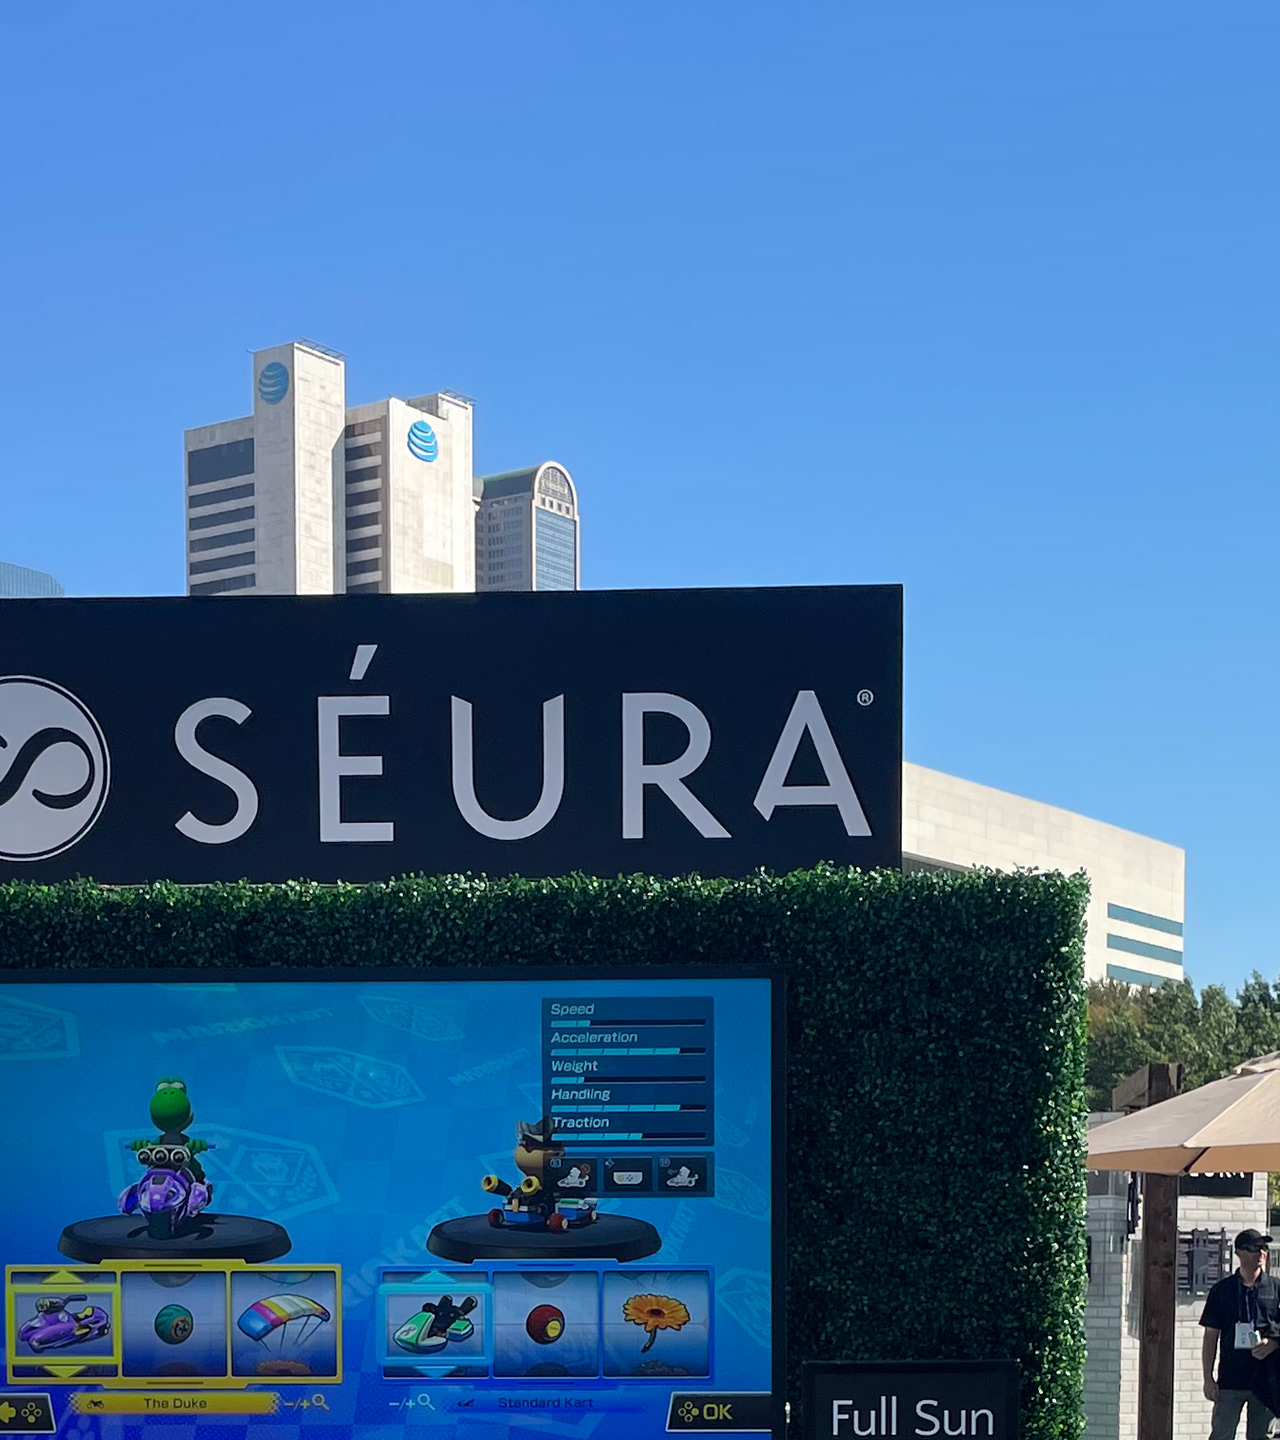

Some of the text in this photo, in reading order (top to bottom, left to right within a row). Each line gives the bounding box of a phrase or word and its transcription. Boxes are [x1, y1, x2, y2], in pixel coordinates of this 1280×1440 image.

[550, 1003, 595, 1017] Speed
[550, 1032, 638, 1043] Acceleration
[551, 1060, 599, 1073] Weight
[551, 1089, 611, 1101] Handling
[552, 1117, 610, 1128] Traction
[143, 1397, 169, 1409] The
[172, 1397, 208, 1409] Duke
[498, 1397, 561, 1409] Standard
[564, 1397, 594, 1409] Kart
[702, 1403, 733, 1420] OK
[832, 1395, 994, 1436] Full Sun
